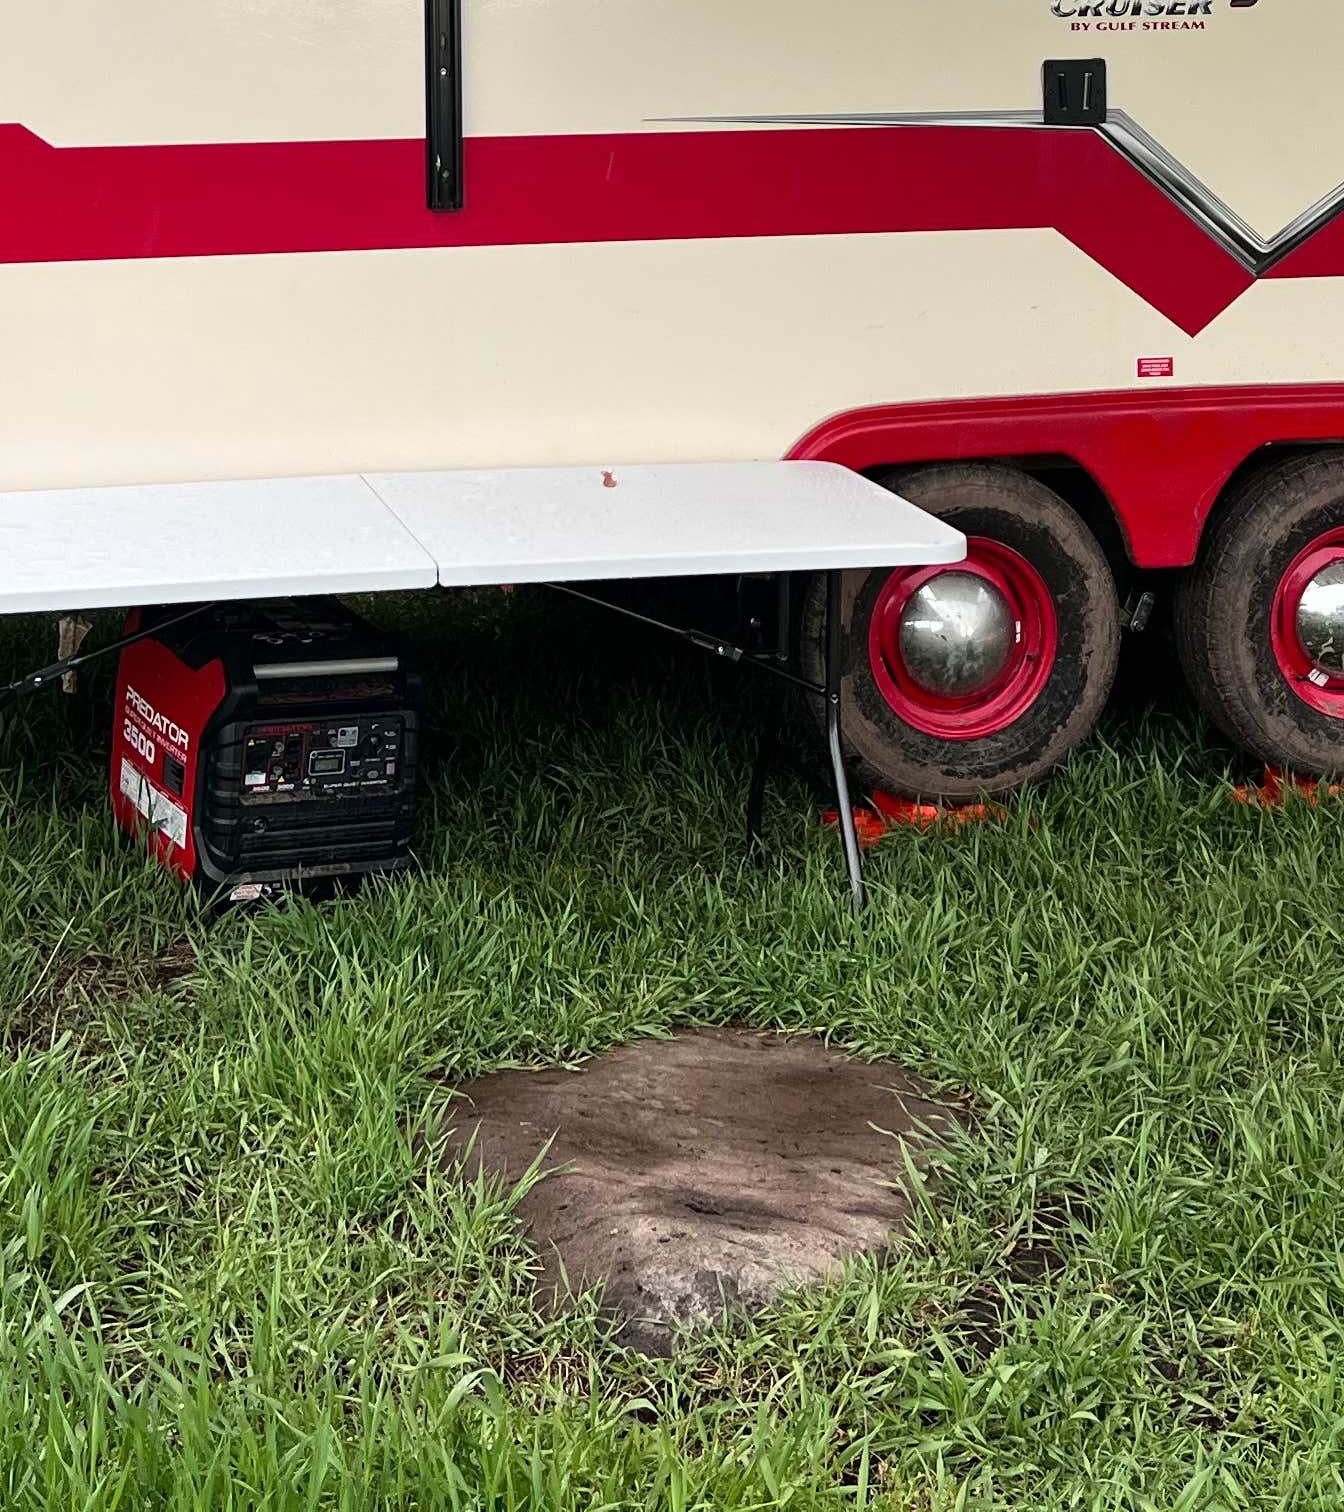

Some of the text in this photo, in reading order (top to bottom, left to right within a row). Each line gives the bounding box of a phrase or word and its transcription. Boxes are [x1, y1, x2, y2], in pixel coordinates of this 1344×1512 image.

[1070, 21, 1205, 31] BY GULF STREAM
[126, 685, 189, 750] PREDATOR
[123, 718, 155, 764] 3500
[156, 734, 187, 763] INVERTER
